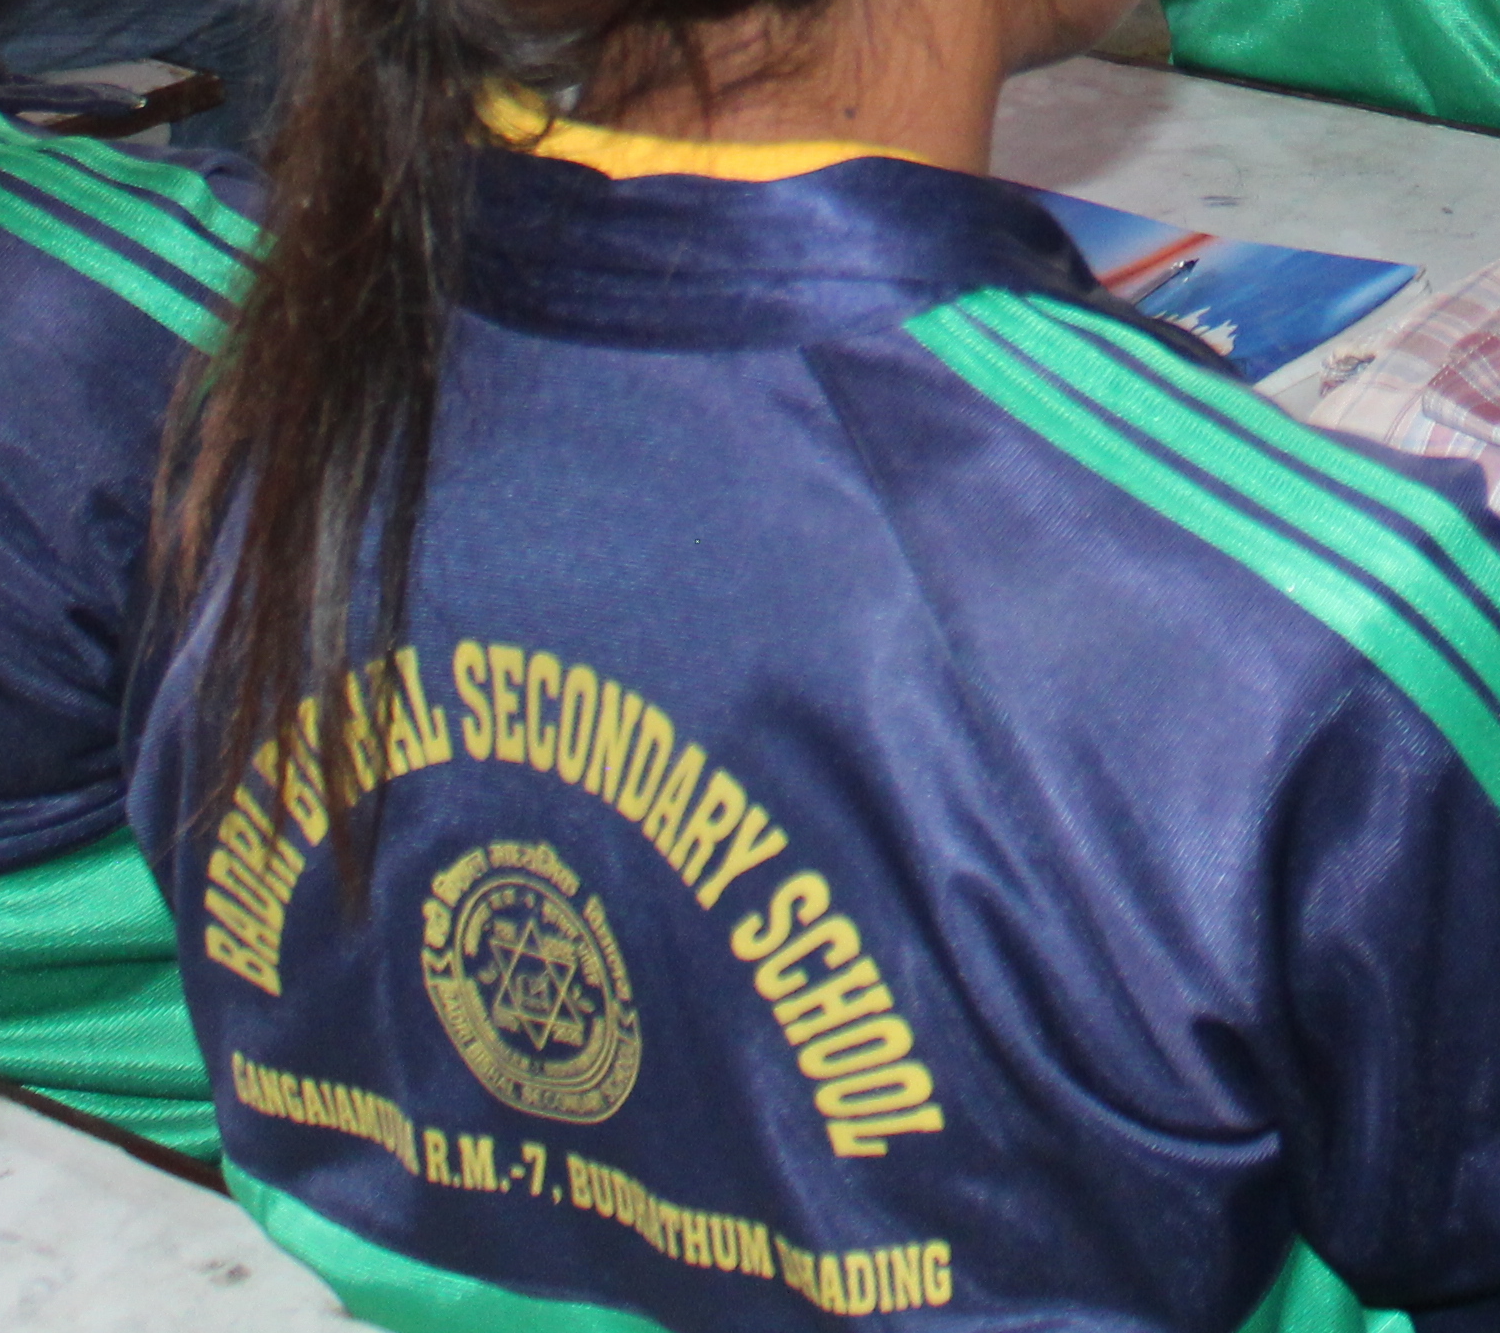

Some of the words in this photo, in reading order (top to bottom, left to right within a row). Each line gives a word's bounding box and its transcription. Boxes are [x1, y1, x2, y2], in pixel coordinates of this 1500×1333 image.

[452, 638, 789, 911] SECONDARY
[730, 869, 945, 1159] SCHOOL
[773, 1235, 954, 1319] DHADING
